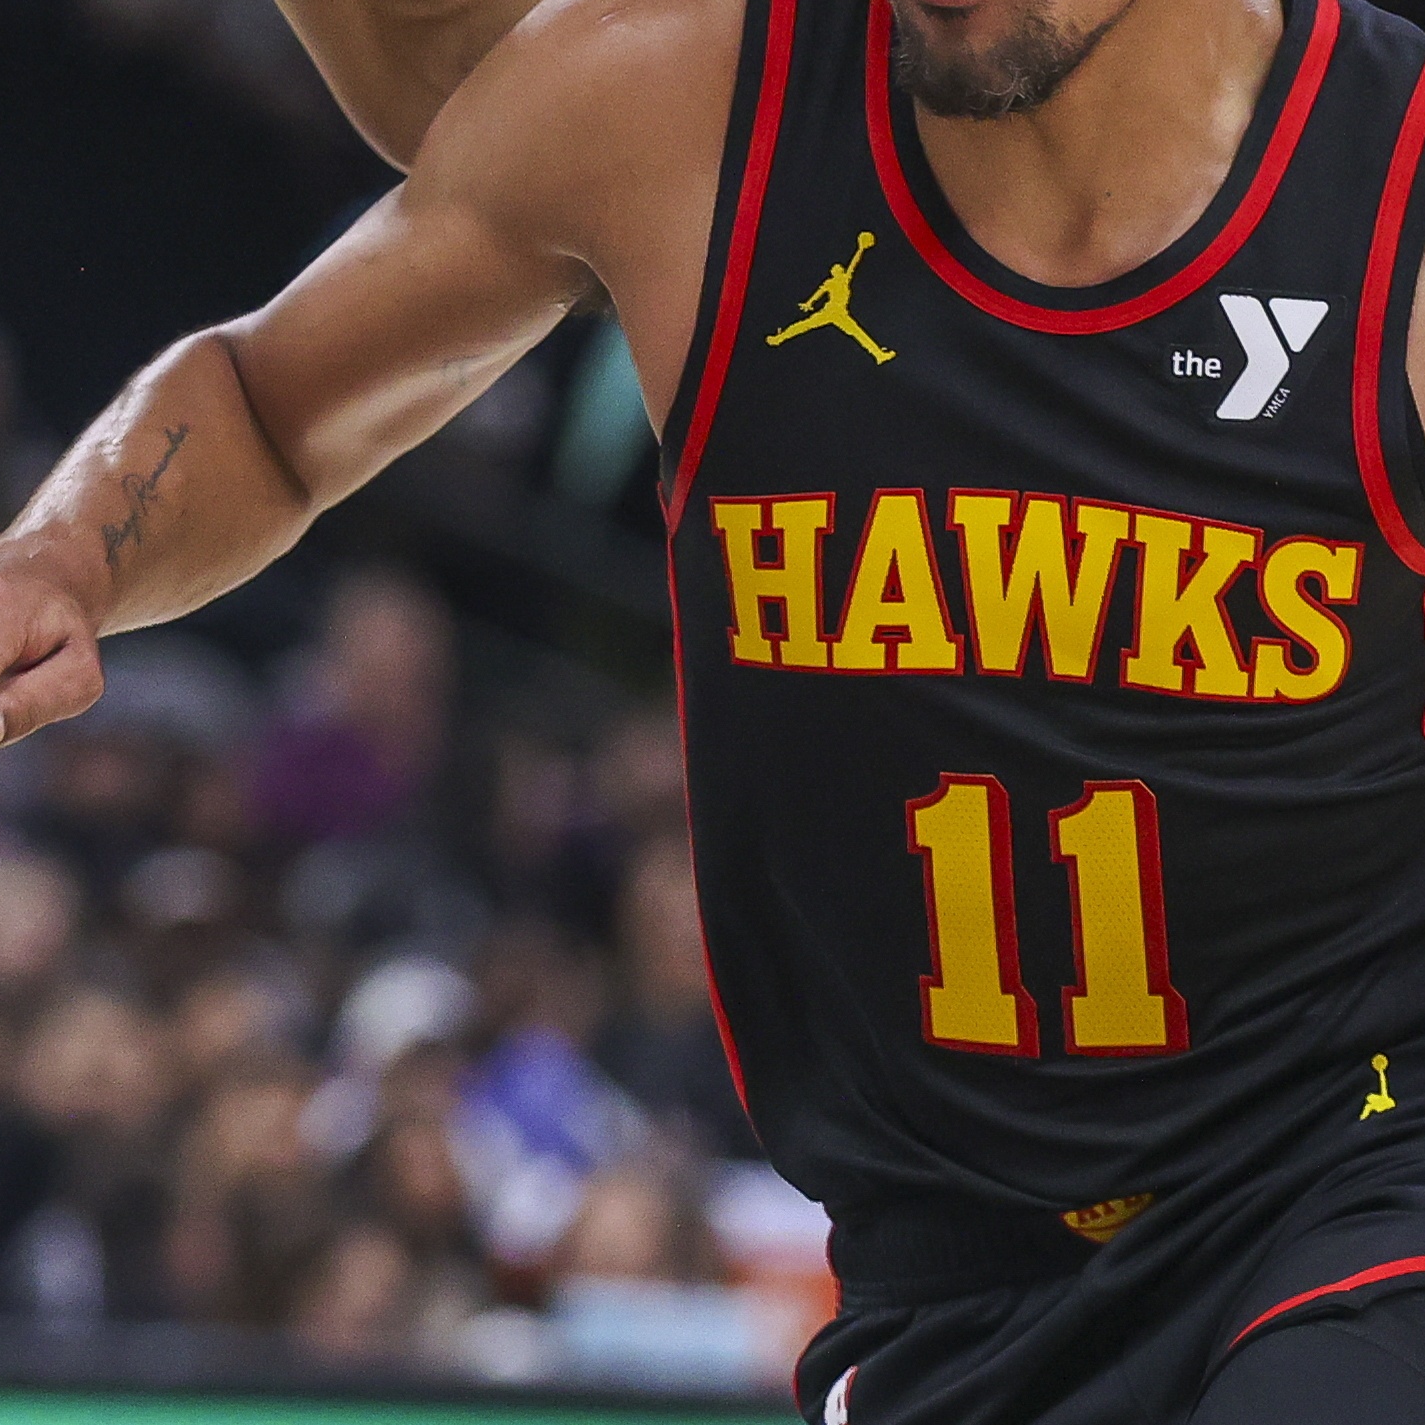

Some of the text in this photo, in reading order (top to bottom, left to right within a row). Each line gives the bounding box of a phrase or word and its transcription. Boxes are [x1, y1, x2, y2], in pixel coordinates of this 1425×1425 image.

[1172, 349, 1221, 378] the
[1262, 387, 1291, 419] YMCA
[708, 488, 1365, 704] HAWKS
[905, 771, 1191, 1059] 11
